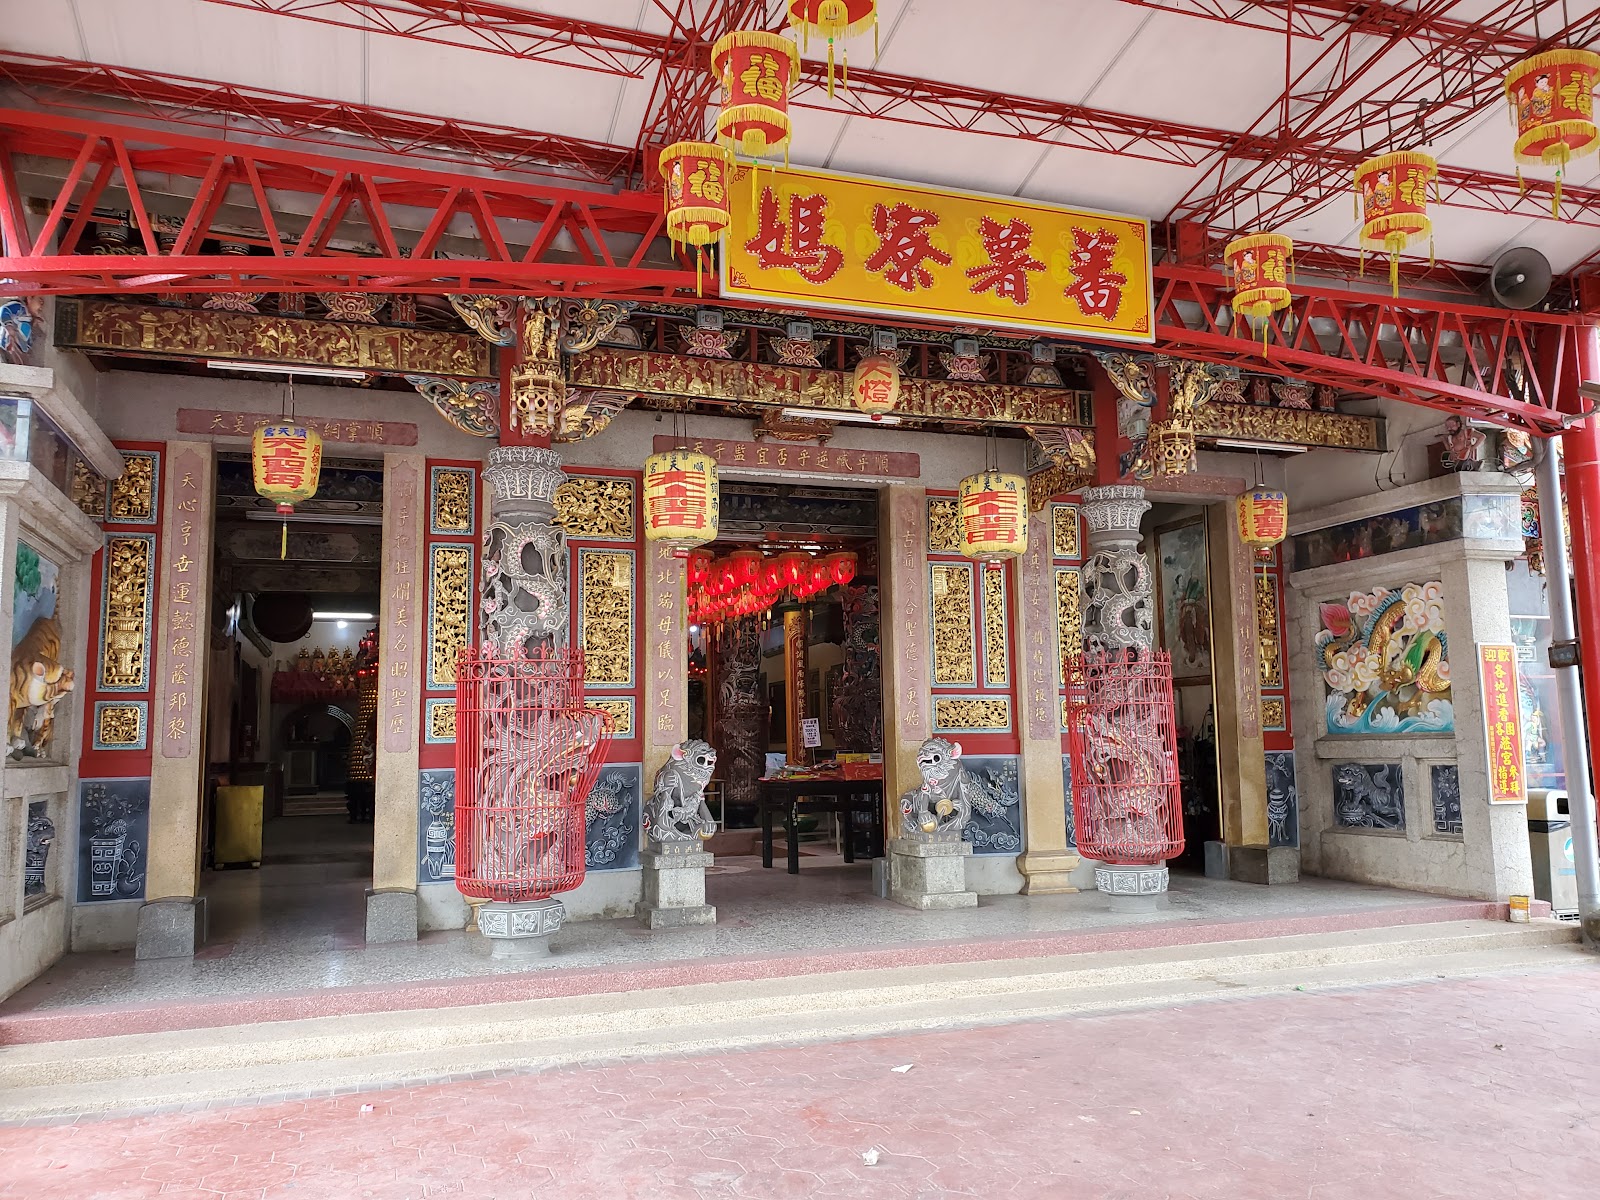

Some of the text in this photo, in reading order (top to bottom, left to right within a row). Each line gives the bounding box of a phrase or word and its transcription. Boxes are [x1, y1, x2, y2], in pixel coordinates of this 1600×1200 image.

[740, 53, 783, 102] 福
[1561, 70, 1594, 116] 福
[687, 160, 725, 204] 福
[1398, 168, 1426, 208] 福
[1262, 249, 1287, 283] 福
[262, 437, 307, 489] 天上聖母
[648, 470, 707, 529] 天上聖母
[963, 490, 1019, 545] 天上聖母
[1253, 499, 1284, 538] 天上聖母
[1485, 649, 1510, 662] 歡迎
